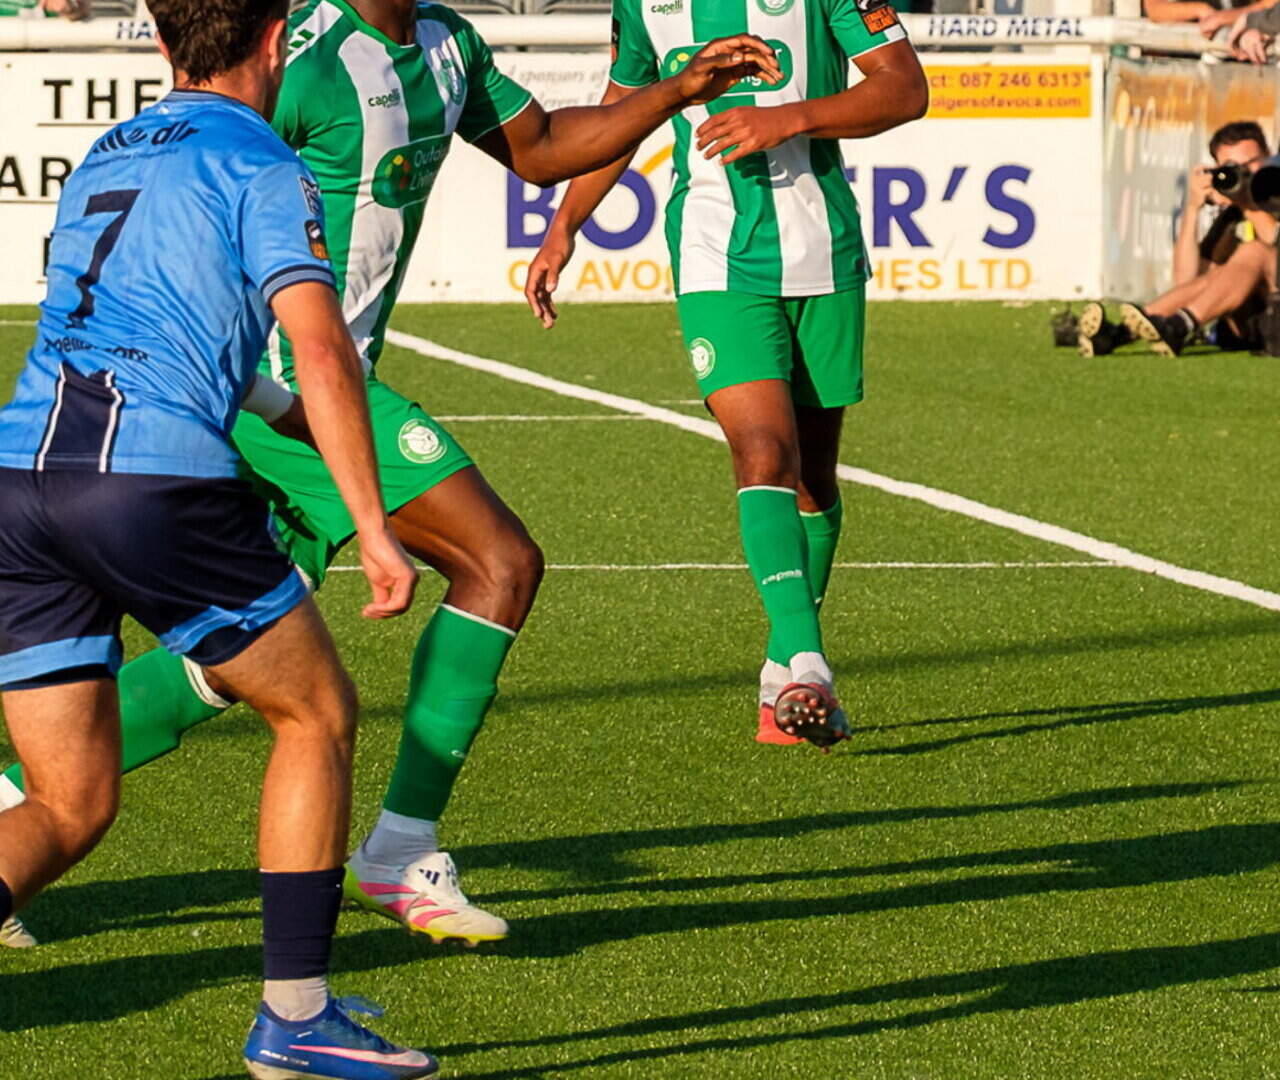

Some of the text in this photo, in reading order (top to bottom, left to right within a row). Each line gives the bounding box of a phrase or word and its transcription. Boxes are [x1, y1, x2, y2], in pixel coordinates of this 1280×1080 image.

[929, 18, 1085, 37] HARD METAL
[959, 71, 992, 88] 087
[999, 71, 1032, 88] 246
[507, 164, 1036, 250] BOR'S
[64, 188, 143, 330] 7
[958, 258, 1033, 291] LTD
